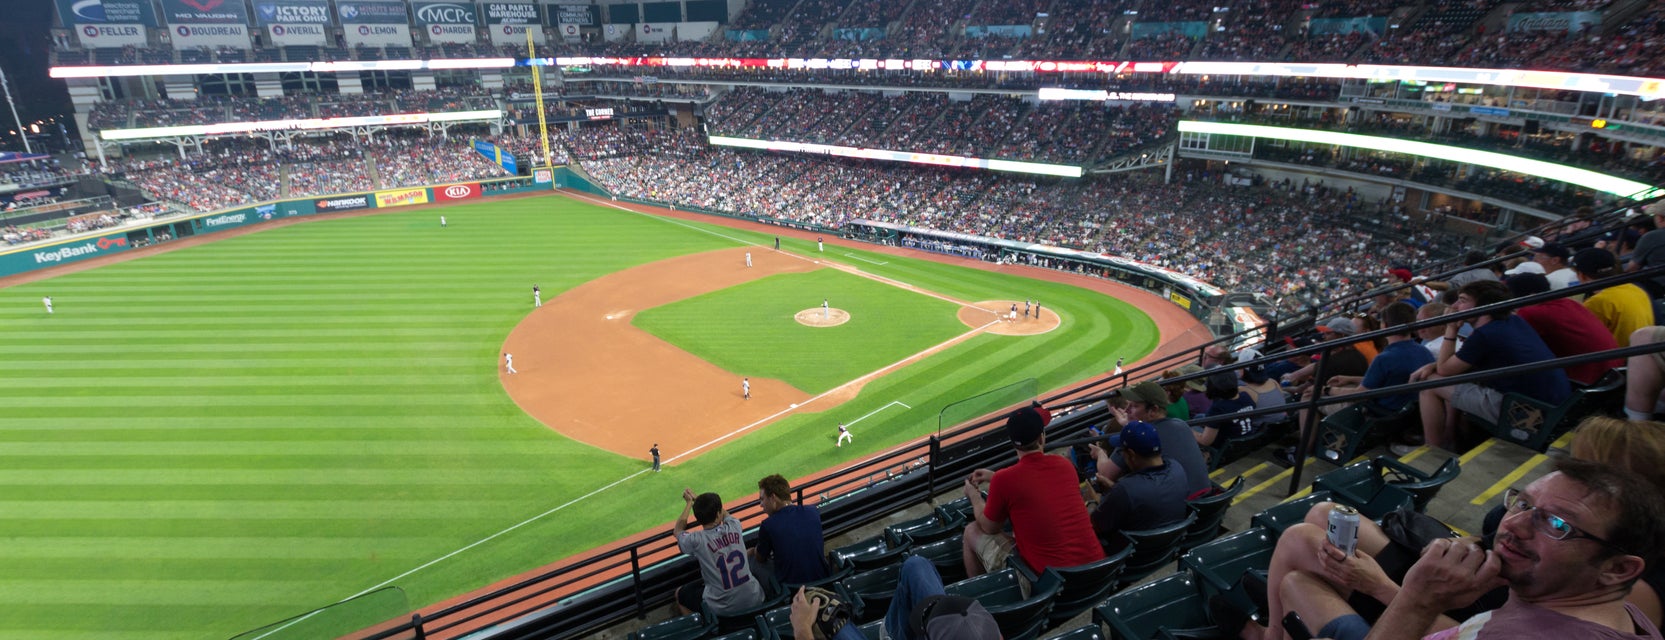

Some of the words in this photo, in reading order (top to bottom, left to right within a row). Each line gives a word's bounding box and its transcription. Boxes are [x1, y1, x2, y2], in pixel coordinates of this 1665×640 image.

[508, 4, 533, 12] PARTS
[276, 14, 302, 22] PARK
[303, 14, 328, 22] OHIO
[99, 27, 138, 36] FELLER
[191, 26, 241, 36] BOUDREAU
[286, 26, 320, 35] AVERILL
[370, 26, 397, 35] LEMON
[443, 26, 472, 34] HARDER
[586, 109, 594, 117] THE
[595, 108, 614, 116] CORNER
[206, 213, 245, 226] FirstEnergy
[34, 243, 98, 263] KeyBank
[707, 532, 740, 553] LINDOR
[716, 549, 750, 590] 12
